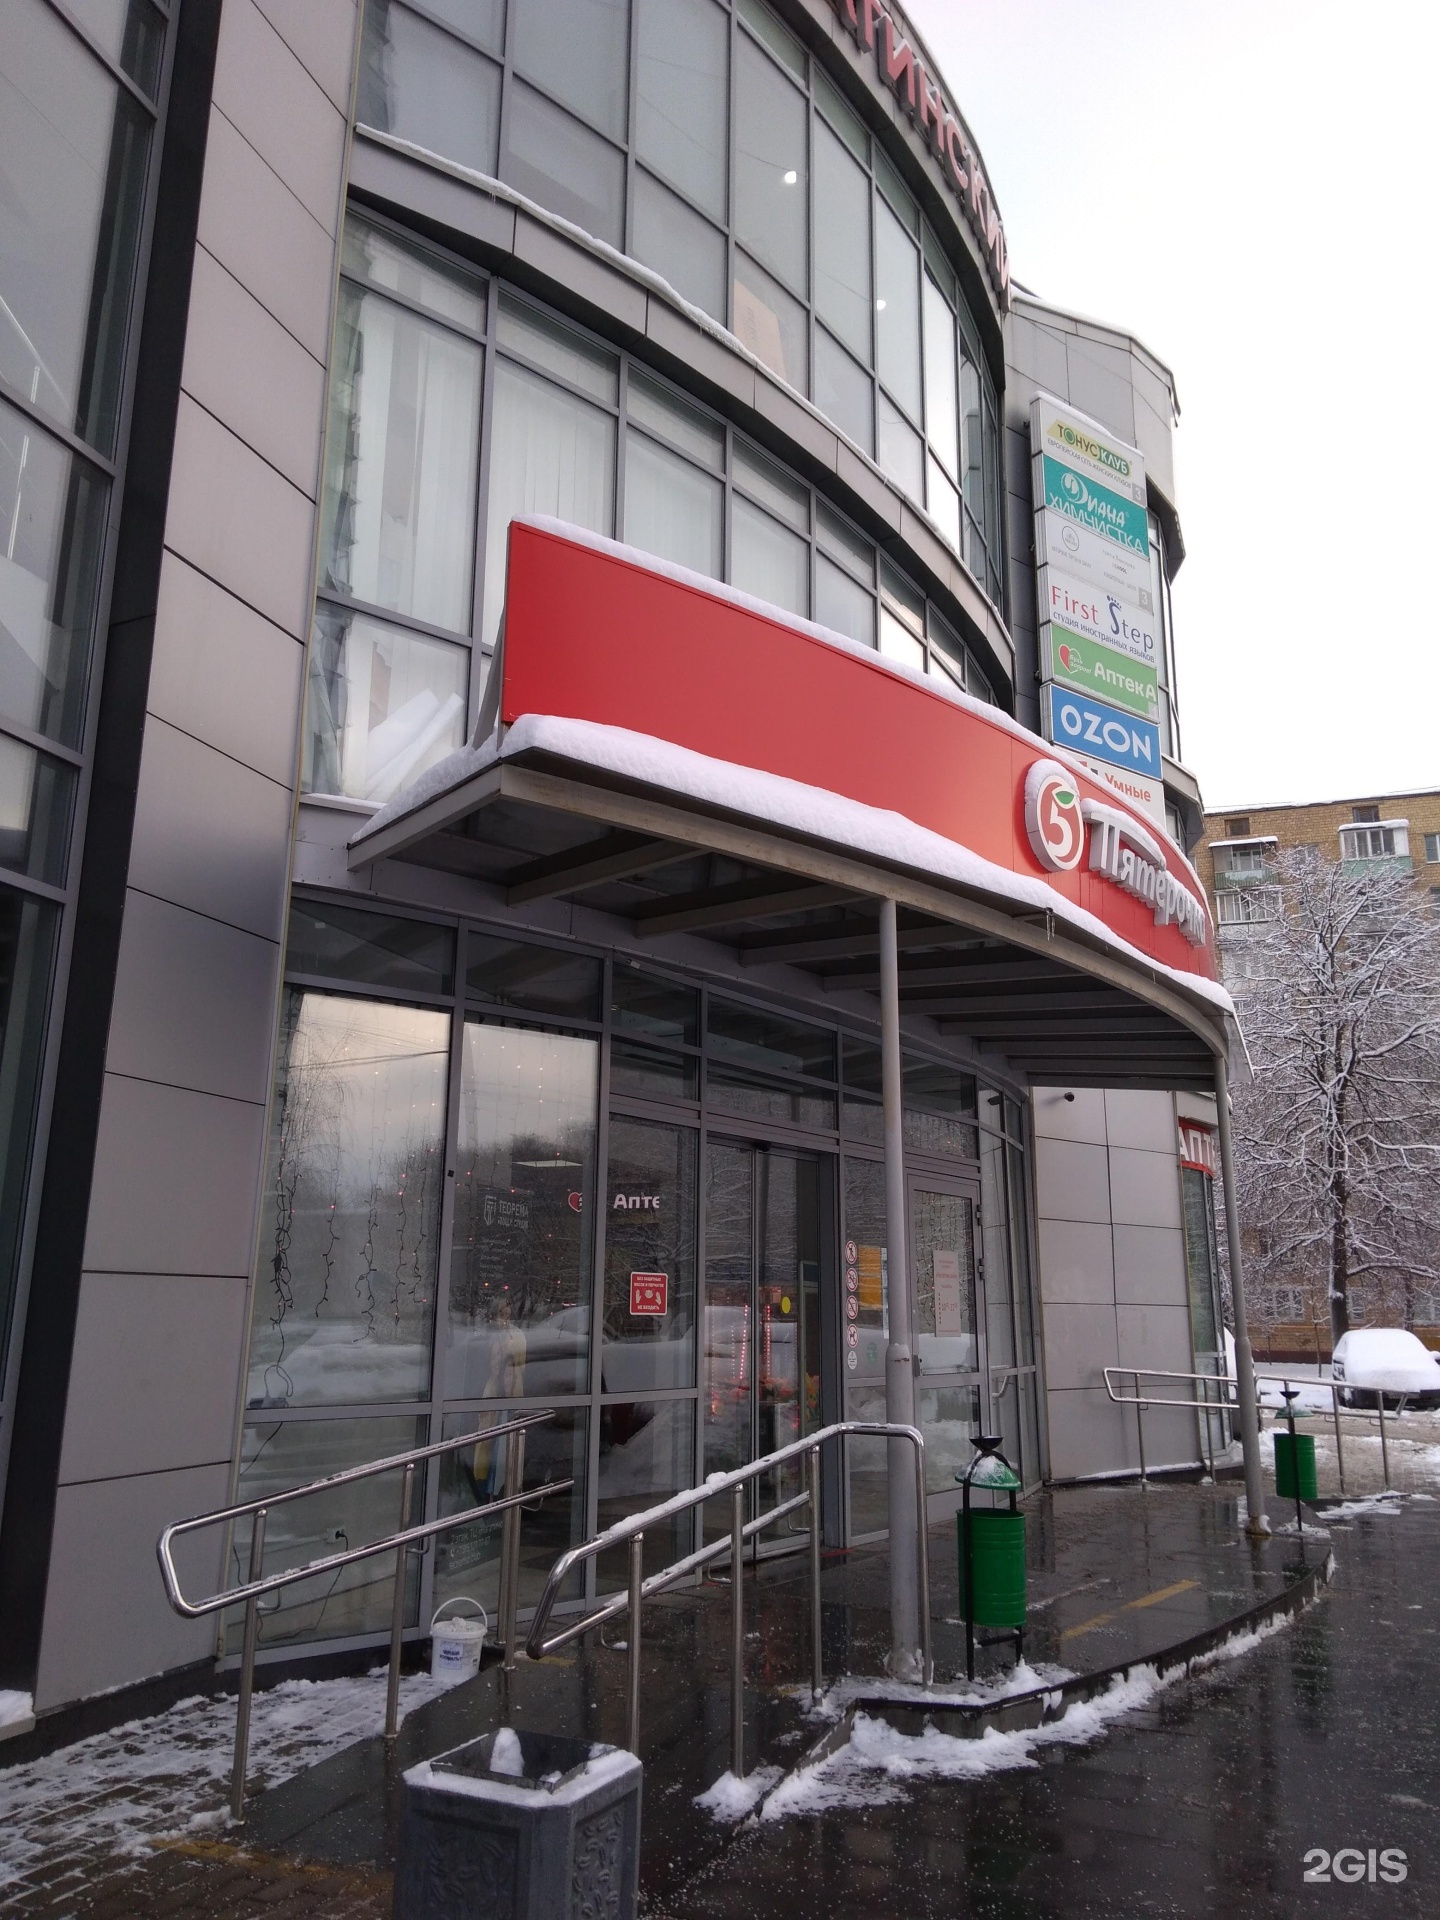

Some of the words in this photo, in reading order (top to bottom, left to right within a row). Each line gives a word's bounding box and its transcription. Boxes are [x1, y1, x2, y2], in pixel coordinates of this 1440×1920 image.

[1049, 491, 1145, 555] ХИМЧИСТКА
[1052, 585, 1099, 626] First
[1107, 595, 1154, 653] Step
[1053, 611, 1079, 629] студия
[1080, 623, 1128, 651] иностранных
[1129, 646, 1155, 663] языков
[1060, 704, 1152, 763] OZON
[1104, 772, 1151, 803] Умные
